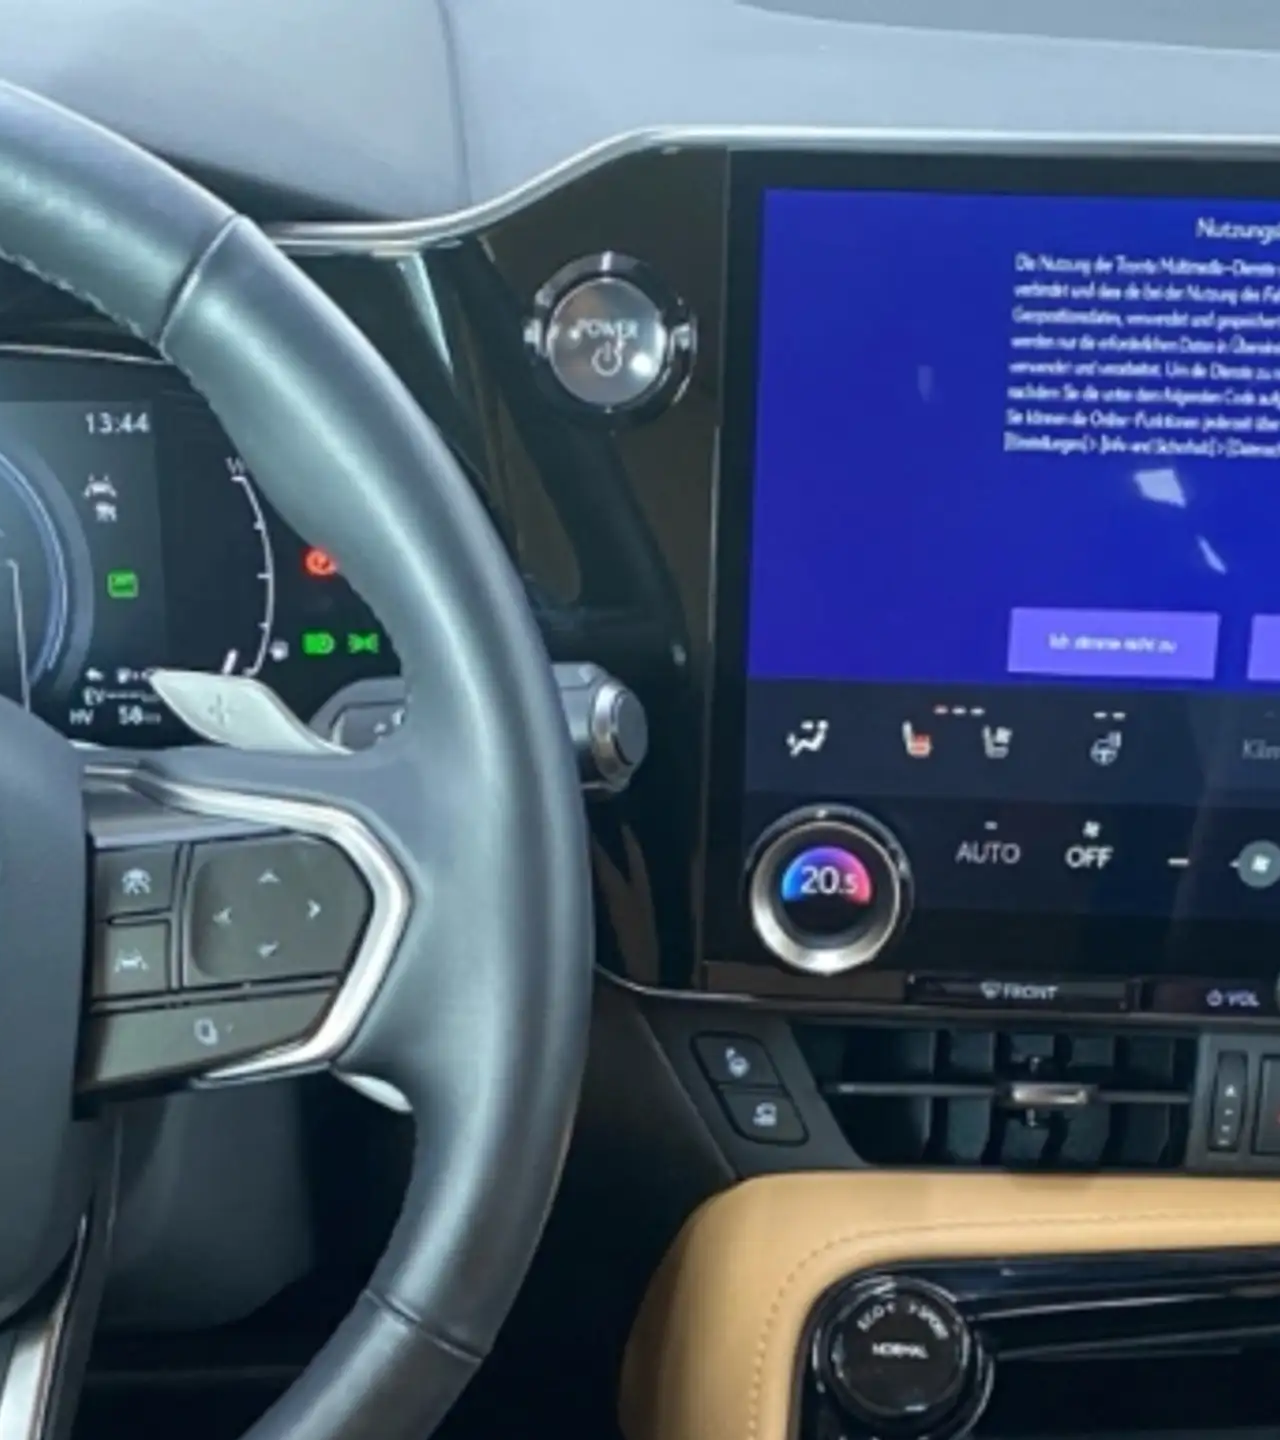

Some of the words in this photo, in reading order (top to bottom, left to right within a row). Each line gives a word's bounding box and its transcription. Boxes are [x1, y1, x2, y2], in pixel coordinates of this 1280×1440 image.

[85, 413, 151, 434] 13:44
[956, 841, 1021, 865] AUTO
[1065, 846, 1114, 869] OFF
[800, 865, 859, 895] 20.5
